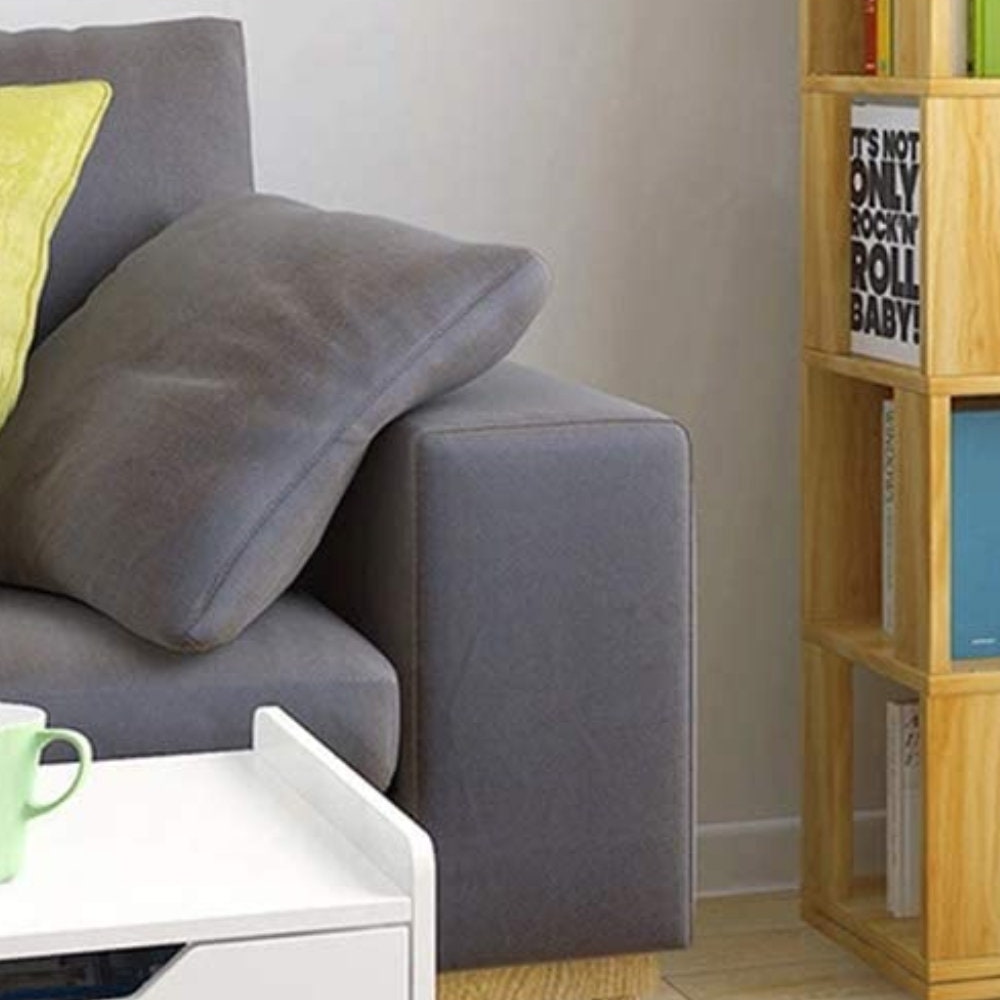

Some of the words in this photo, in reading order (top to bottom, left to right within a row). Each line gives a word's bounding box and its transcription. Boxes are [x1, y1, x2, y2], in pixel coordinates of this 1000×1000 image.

[882, 129, 920, 161] NOT
[850, 157, 920, 214] ONLY
[851, 240, 920, 299] ROLL
[851, 291, 920, 345] BABY!
